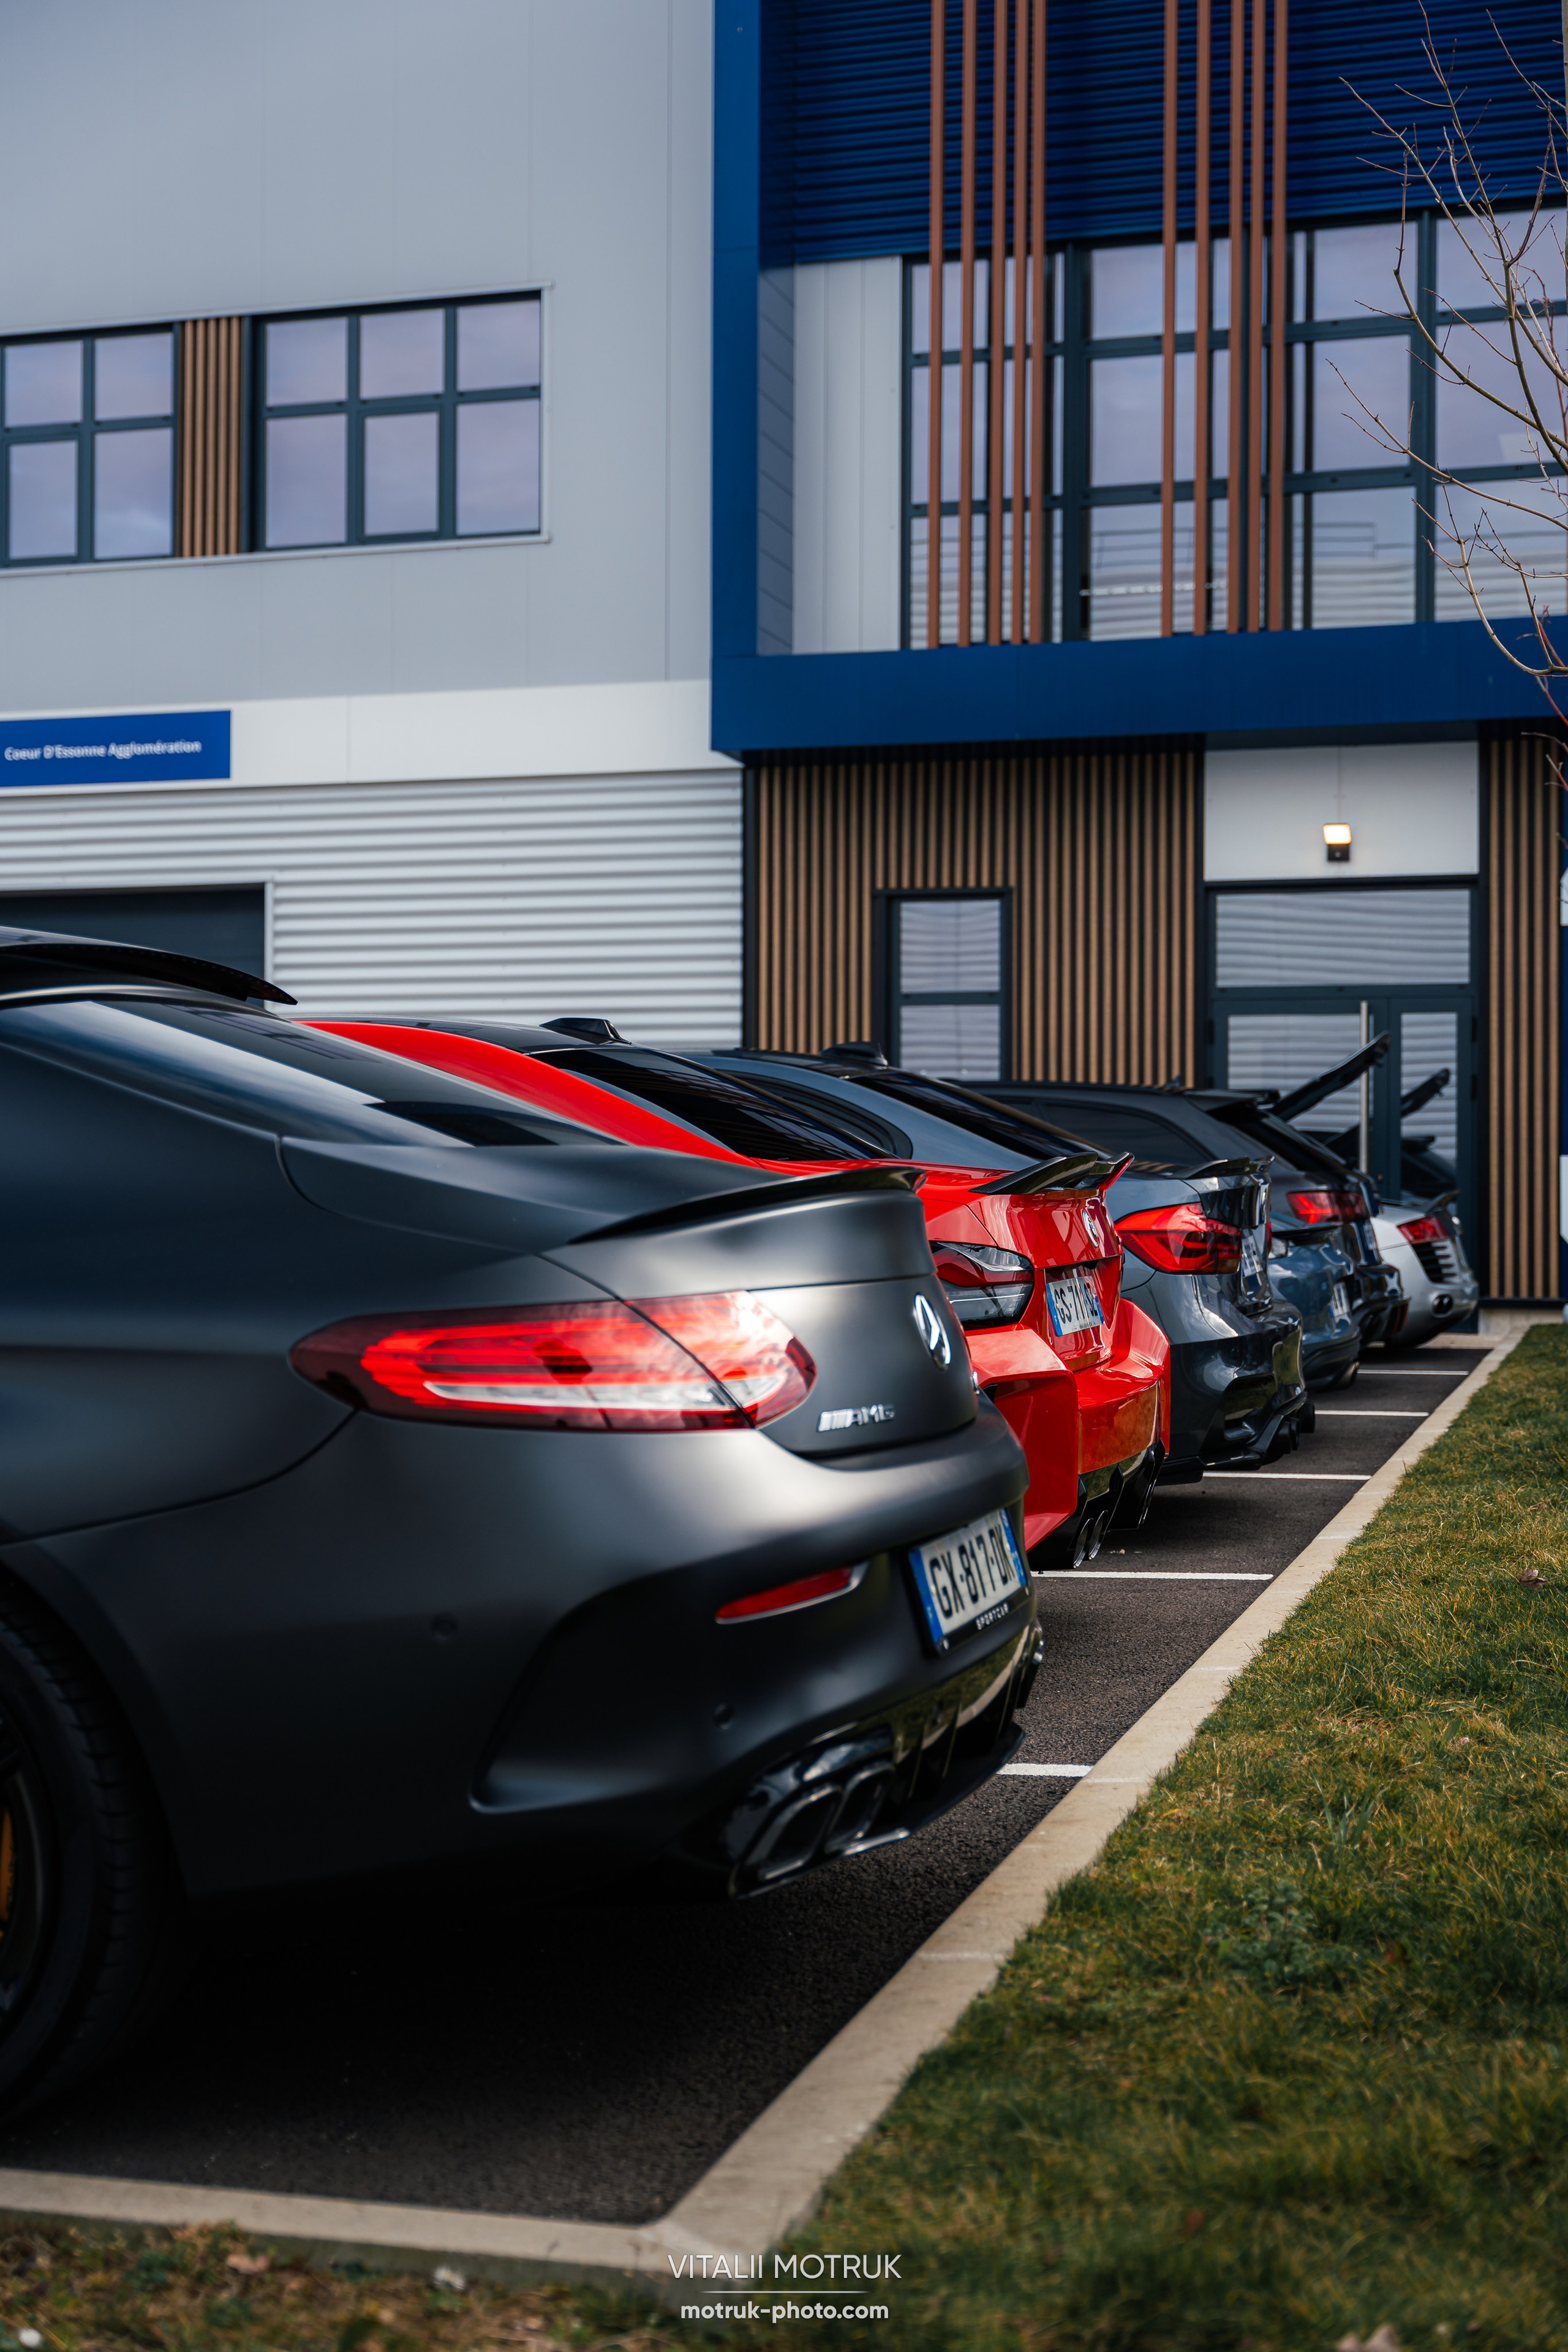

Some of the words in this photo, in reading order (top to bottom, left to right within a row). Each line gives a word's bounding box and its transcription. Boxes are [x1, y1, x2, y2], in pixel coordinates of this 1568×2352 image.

[4, 746, 42, 761] Coeur
[43, 744, 107, 760] D'Essonne
[107, 739, 202, 760] Agglomération
[929, 1525, 1016, 1619] GX-817-DK
[975, 1602, 1009, 1630] SPORTCAR
